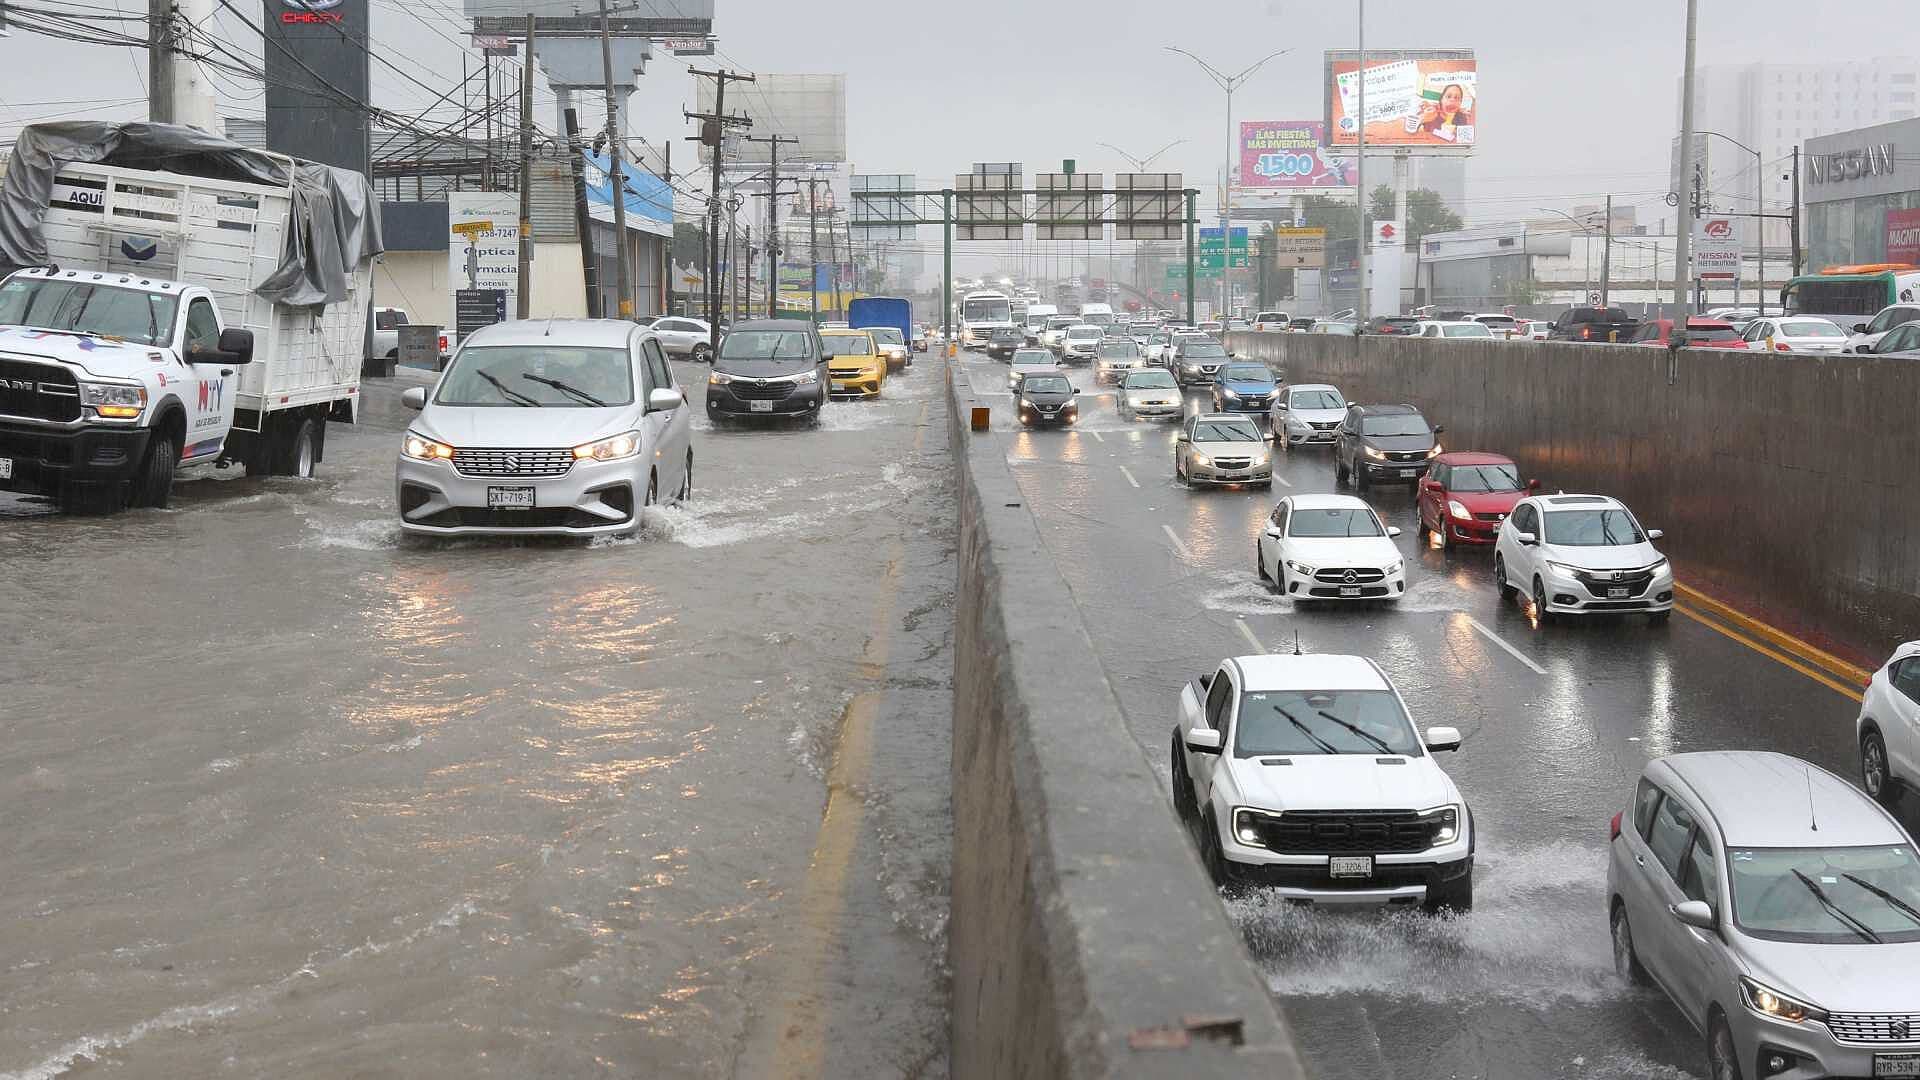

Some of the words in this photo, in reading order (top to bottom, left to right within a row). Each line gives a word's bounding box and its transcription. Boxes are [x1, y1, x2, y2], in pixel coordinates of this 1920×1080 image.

[1808, 143, 1895, 185] NISSAN
[1888, 227, 1920, 248] MAGNIT
[1698, 252, 1737, 260] NISSAN
[463, 264, 517, 274] Frmacia
